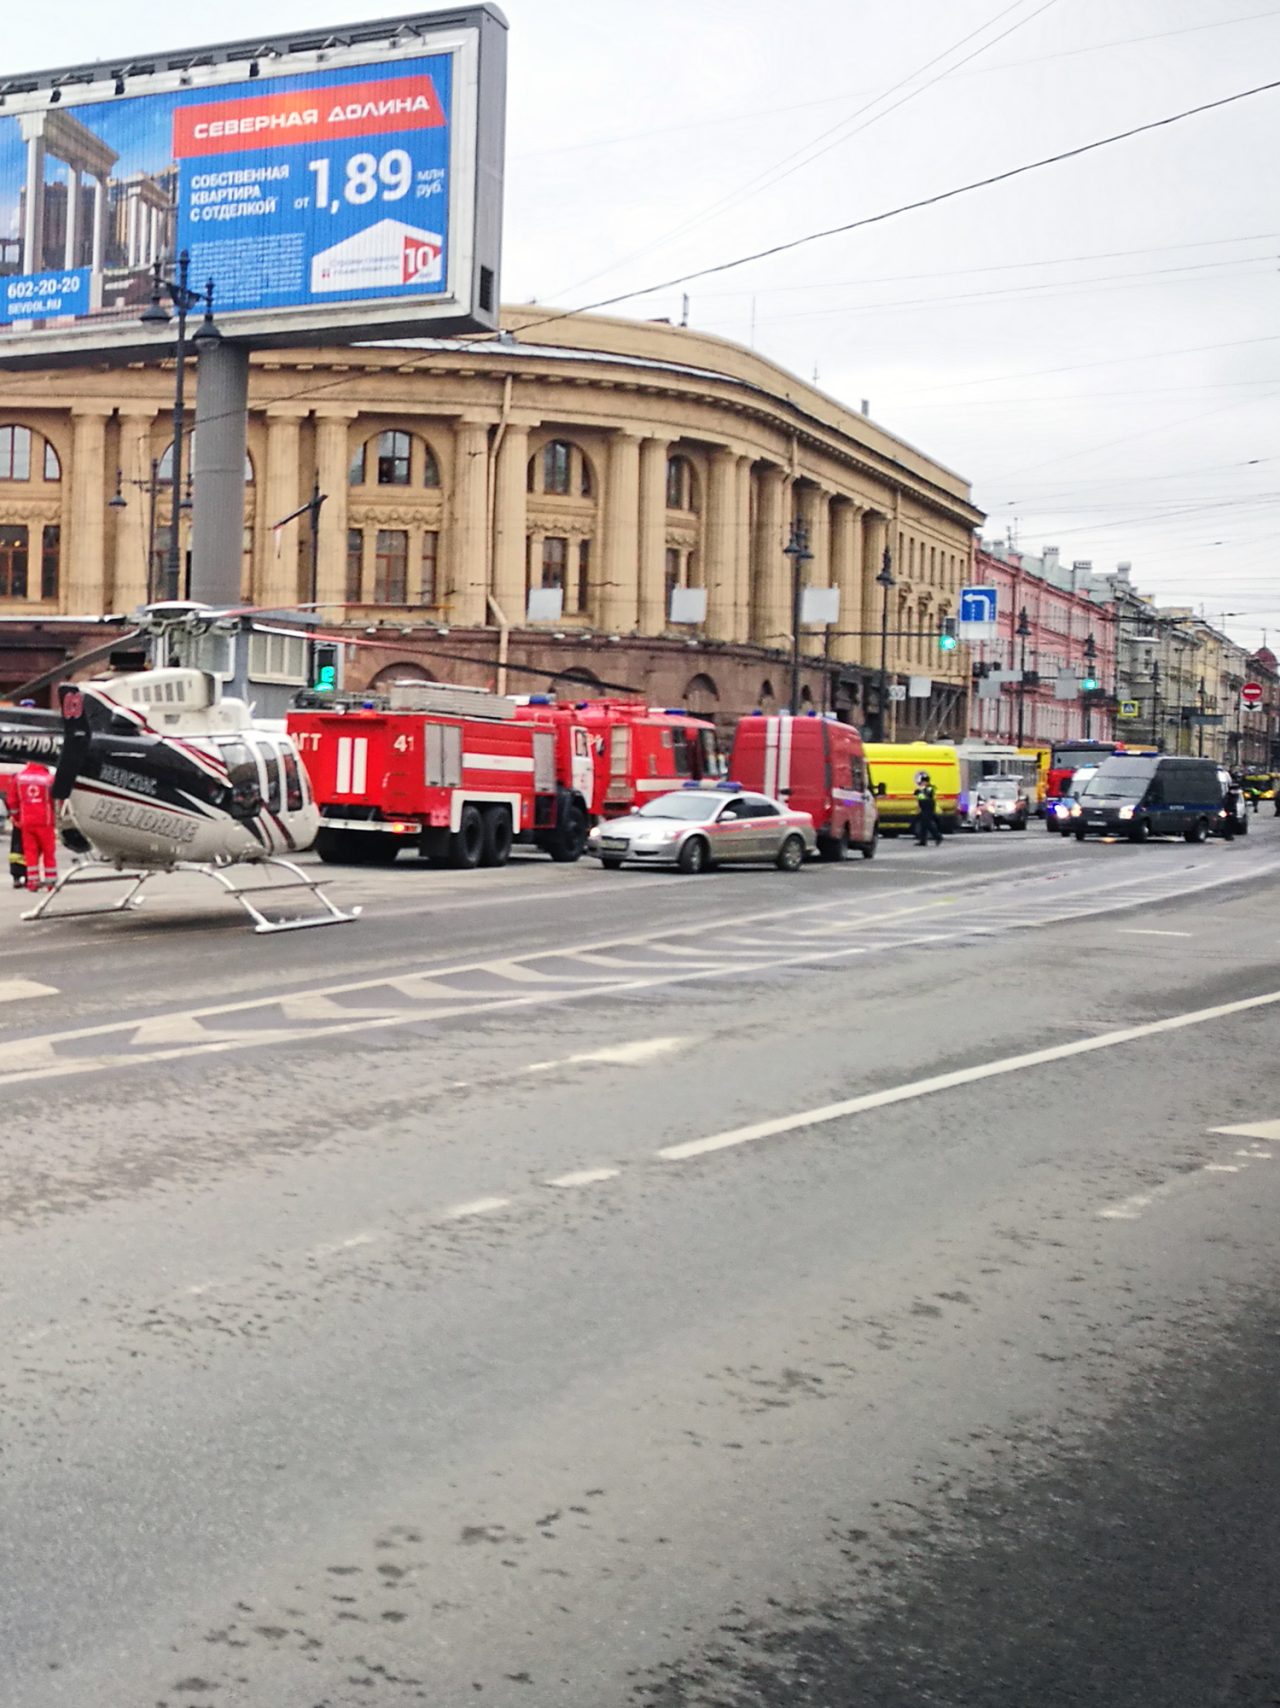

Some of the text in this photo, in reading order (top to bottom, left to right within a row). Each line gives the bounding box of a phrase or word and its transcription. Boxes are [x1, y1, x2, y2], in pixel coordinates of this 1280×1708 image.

[193, 95, 430, 140] СЕВЕРНАЯ ДОЛИНА
[191, 164, 290, 190] СОБСТВЕННАЯ
[309, 149, 413, 214] 1,89
[191, 185, 262, 206] КВАРТИРА
[294, 198, 310, 209] от
[190, 196, 276, 222] С ОТДЕЛКОЙ
[405, 246, 434, 273] 10
[7, 275, 81, 299] 602-20-20
[393, 734, 415, 752] 41
